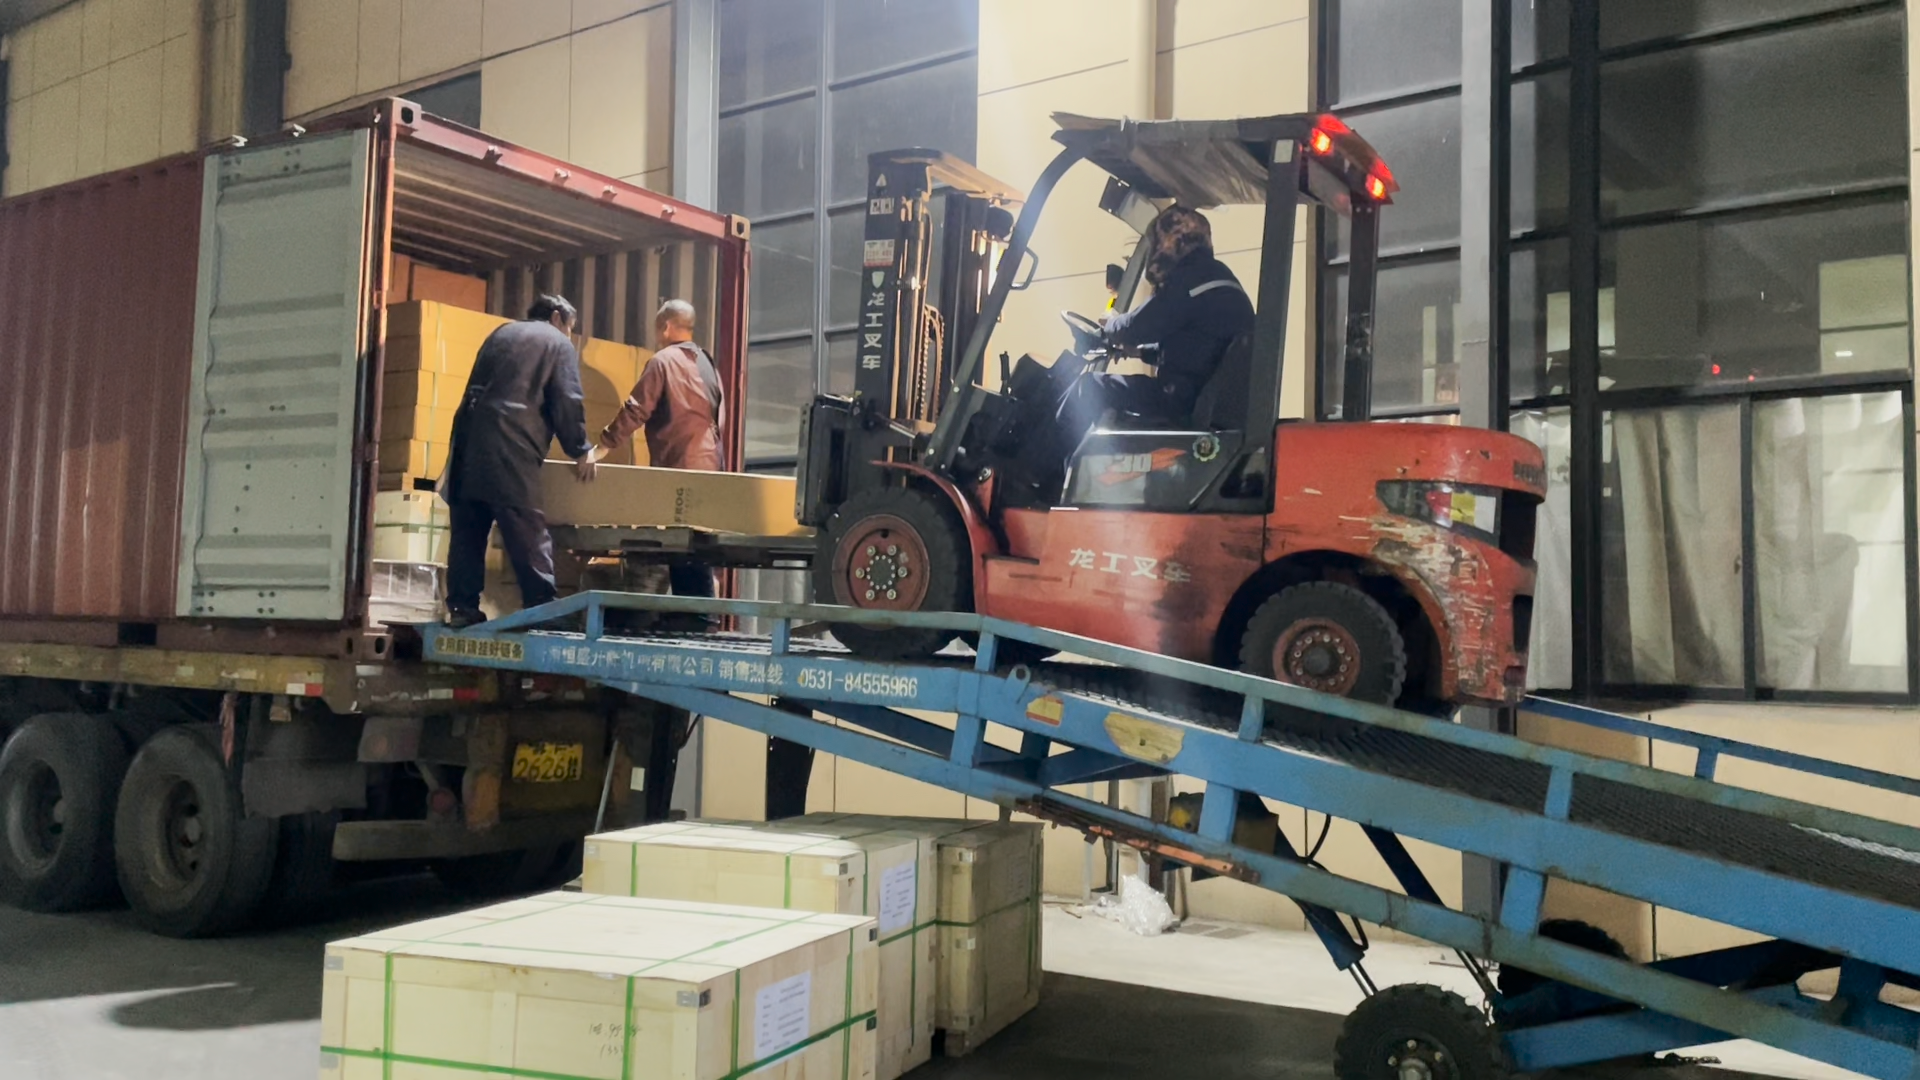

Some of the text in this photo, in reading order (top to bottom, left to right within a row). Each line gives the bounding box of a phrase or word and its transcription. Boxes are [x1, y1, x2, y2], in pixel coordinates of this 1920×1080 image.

[862, 292, 885, 370] 龙工叉车
[1068, 547, 1192, 583] 龙工叉车
[799, 666, 919, 699] 0531-84555966
